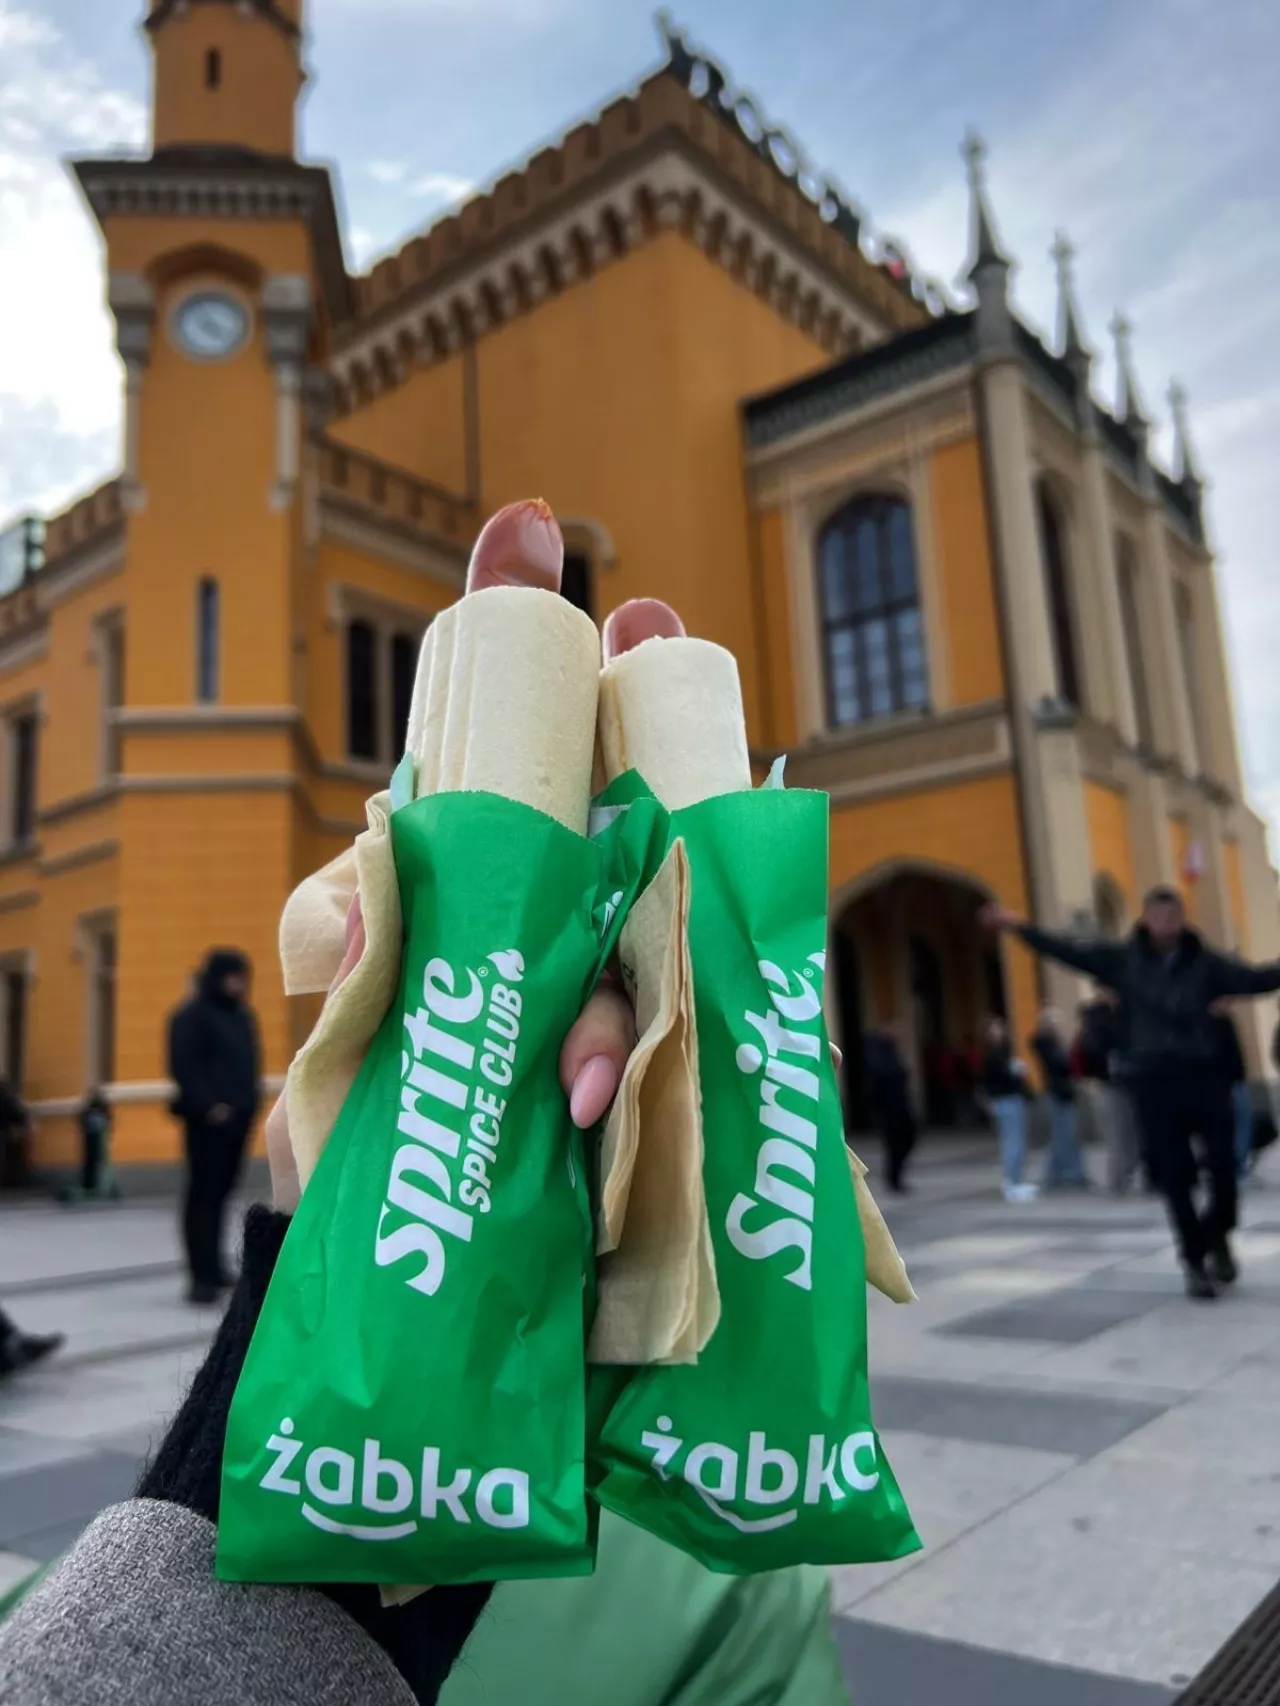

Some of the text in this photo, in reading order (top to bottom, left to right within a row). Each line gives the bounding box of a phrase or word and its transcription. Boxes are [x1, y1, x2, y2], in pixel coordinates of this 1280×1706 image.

[458, 983, 522, 1213] SPICE CLUB
[260, 1416, 529, 1529] żabka
